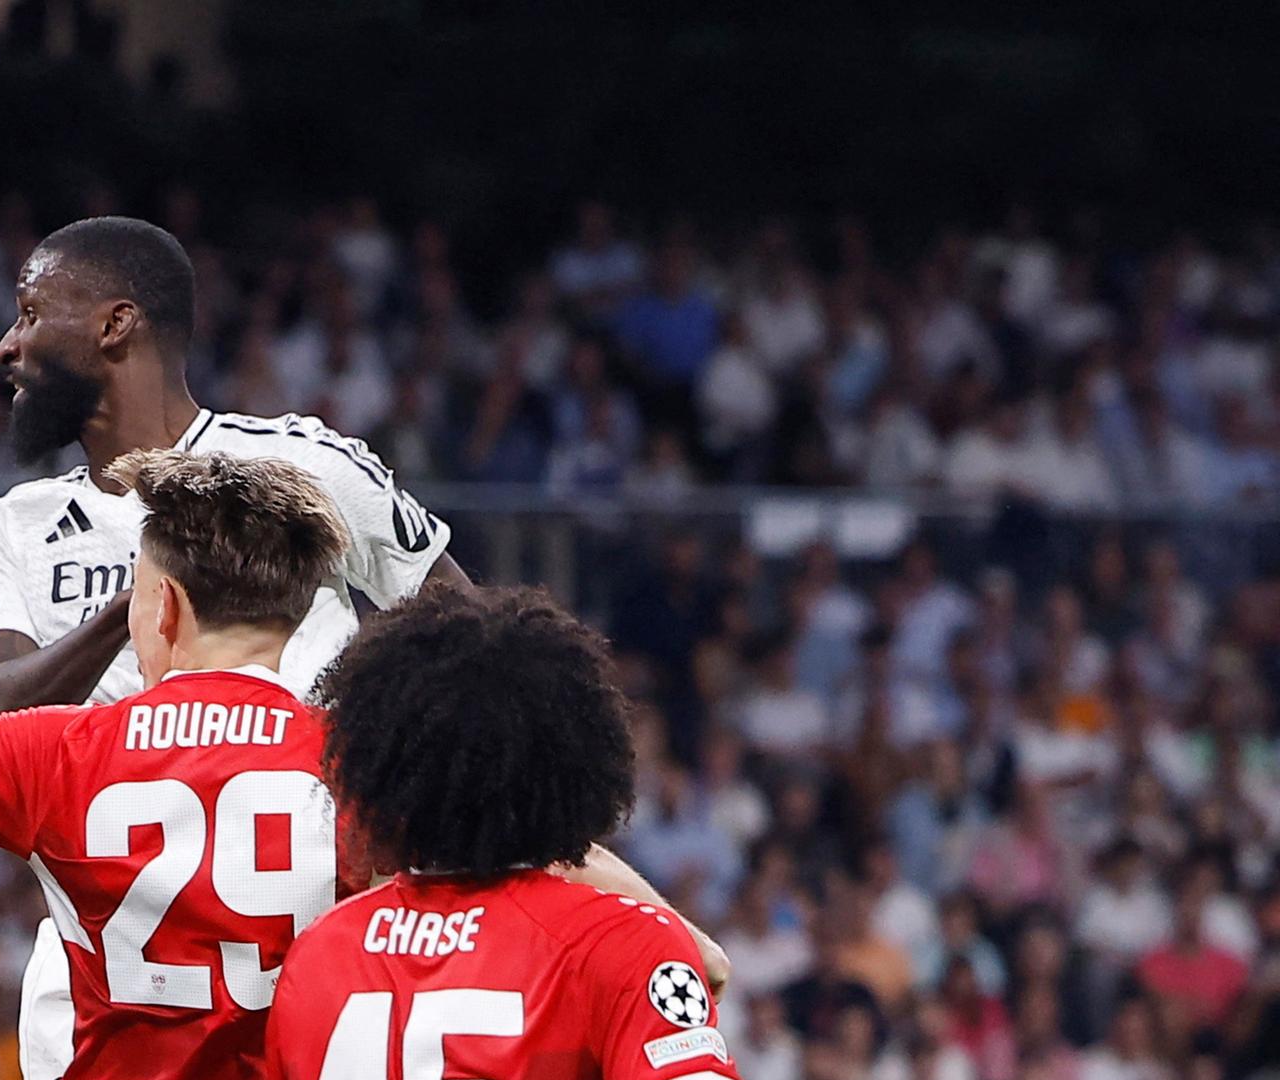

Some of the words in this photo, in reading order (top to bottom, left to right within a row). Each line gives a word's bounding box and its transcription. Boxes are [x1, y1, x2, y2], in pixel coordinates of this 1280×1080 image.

[125, 701, 294, 750] ROUAULT
[86, 770, 337, 1011] 29
[363, 906, 485, 957] CHASE
